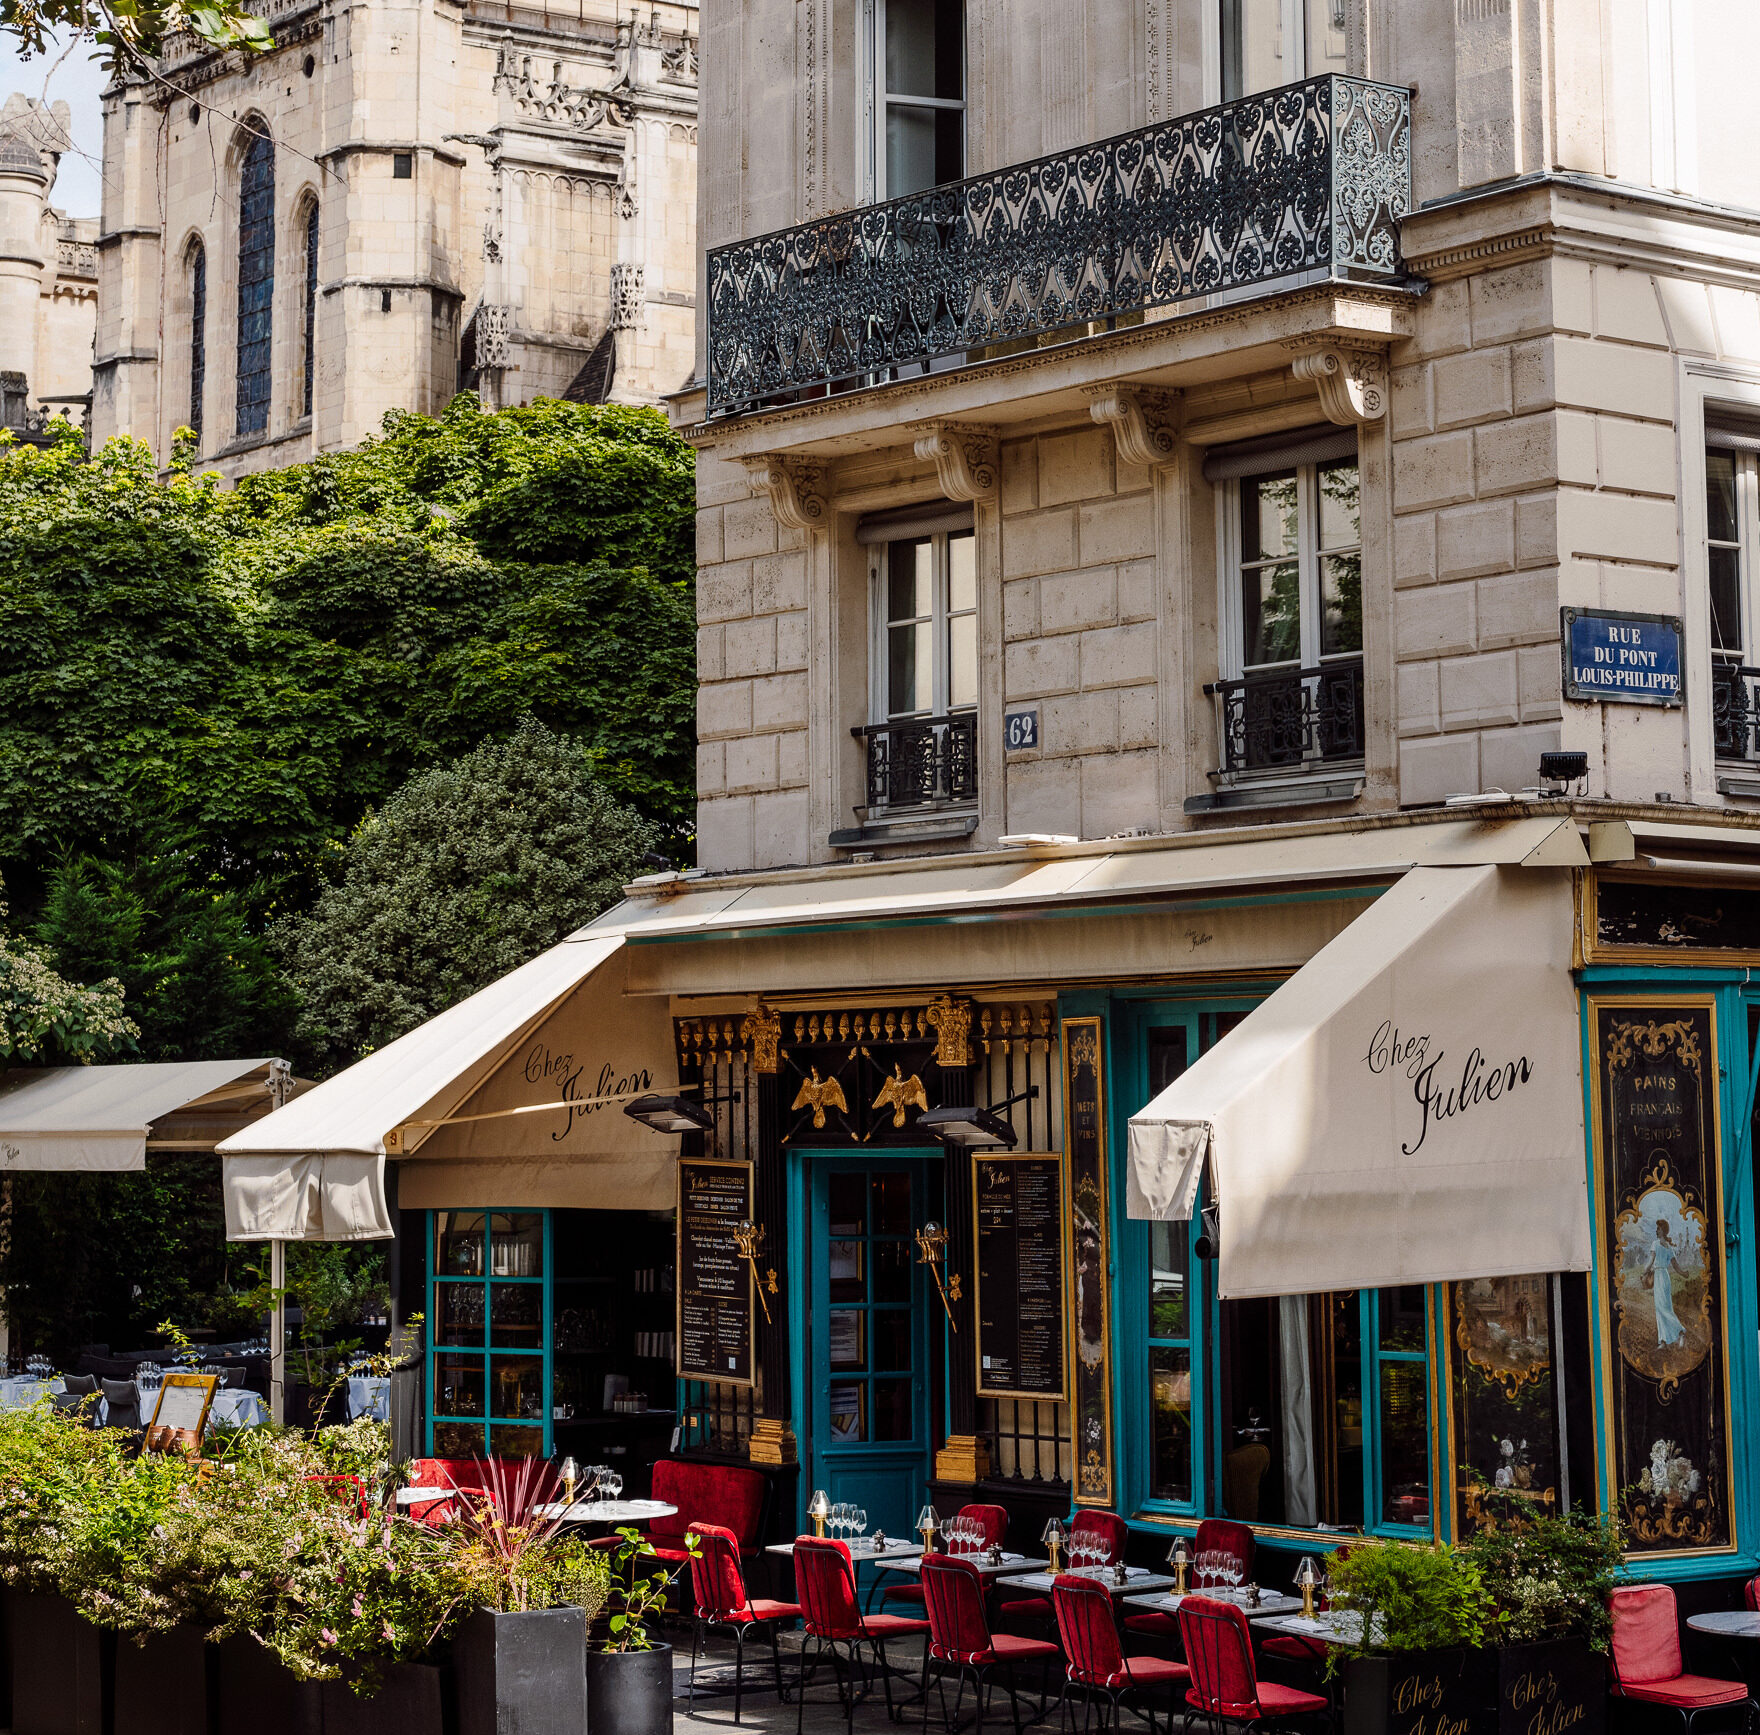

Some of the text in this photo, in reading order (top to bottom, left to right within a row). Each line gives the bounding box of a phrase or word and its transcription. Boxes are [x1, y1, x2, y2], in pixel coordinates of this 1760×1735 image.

[1608, 626, 1641, 645] RUE
[1594, 646, 1658, 667] DU PONT
[1573, 666, 1680, 690] LOUIS-PHILIPPE
[1009, 716, 1033, 745] 62
[1360, 1020, 1431, 1079] Chez
[520, 1043, 574, 1087] Chez
[1634, 1074, 1677, 1093] PAINS
[552, 1063, 654, 1141] Julien
[1076, 1101, 1095, 1113] METS
[1402, 1048, 1534, 1156] Julien
[1081, 1115, 1090, 1125] ET
[1392, 1675, 1445, 1714] Chez
[1505, 1671, 1558, 1710] Chez
[1409, 1714, 1471, 1735] lien
